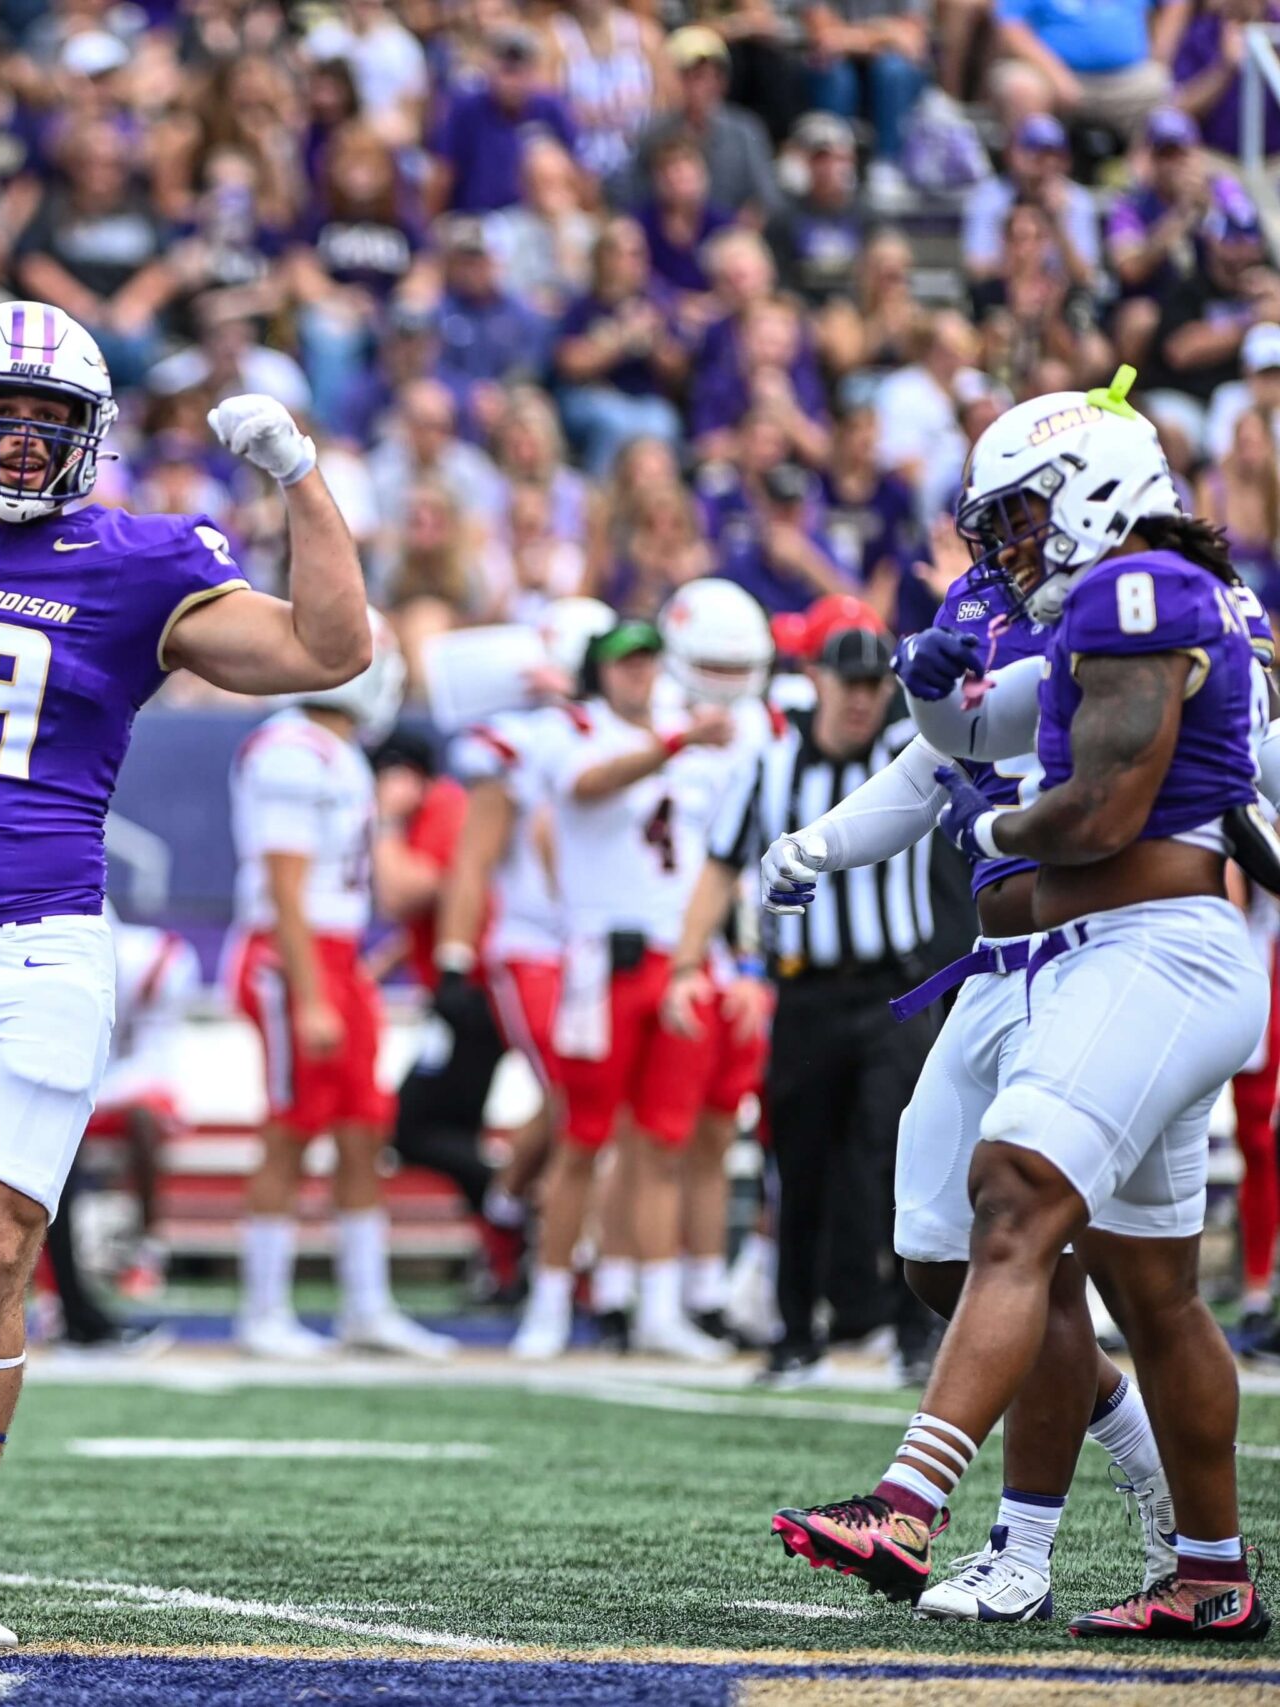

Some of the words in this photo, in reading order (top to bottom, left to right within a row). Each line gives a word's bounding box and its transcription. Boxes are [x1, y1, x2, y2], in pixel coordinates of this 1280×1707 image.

[10, 362, 52, 376] DUKES
[1029, 406, 1104, 446] JMU
[957, 601, 990, 622] SBC
[1116, 572, 1157, 634] 8
[643, 796, 676, 874] 4
[1193, 1588, 1239, 1631] NIKE
